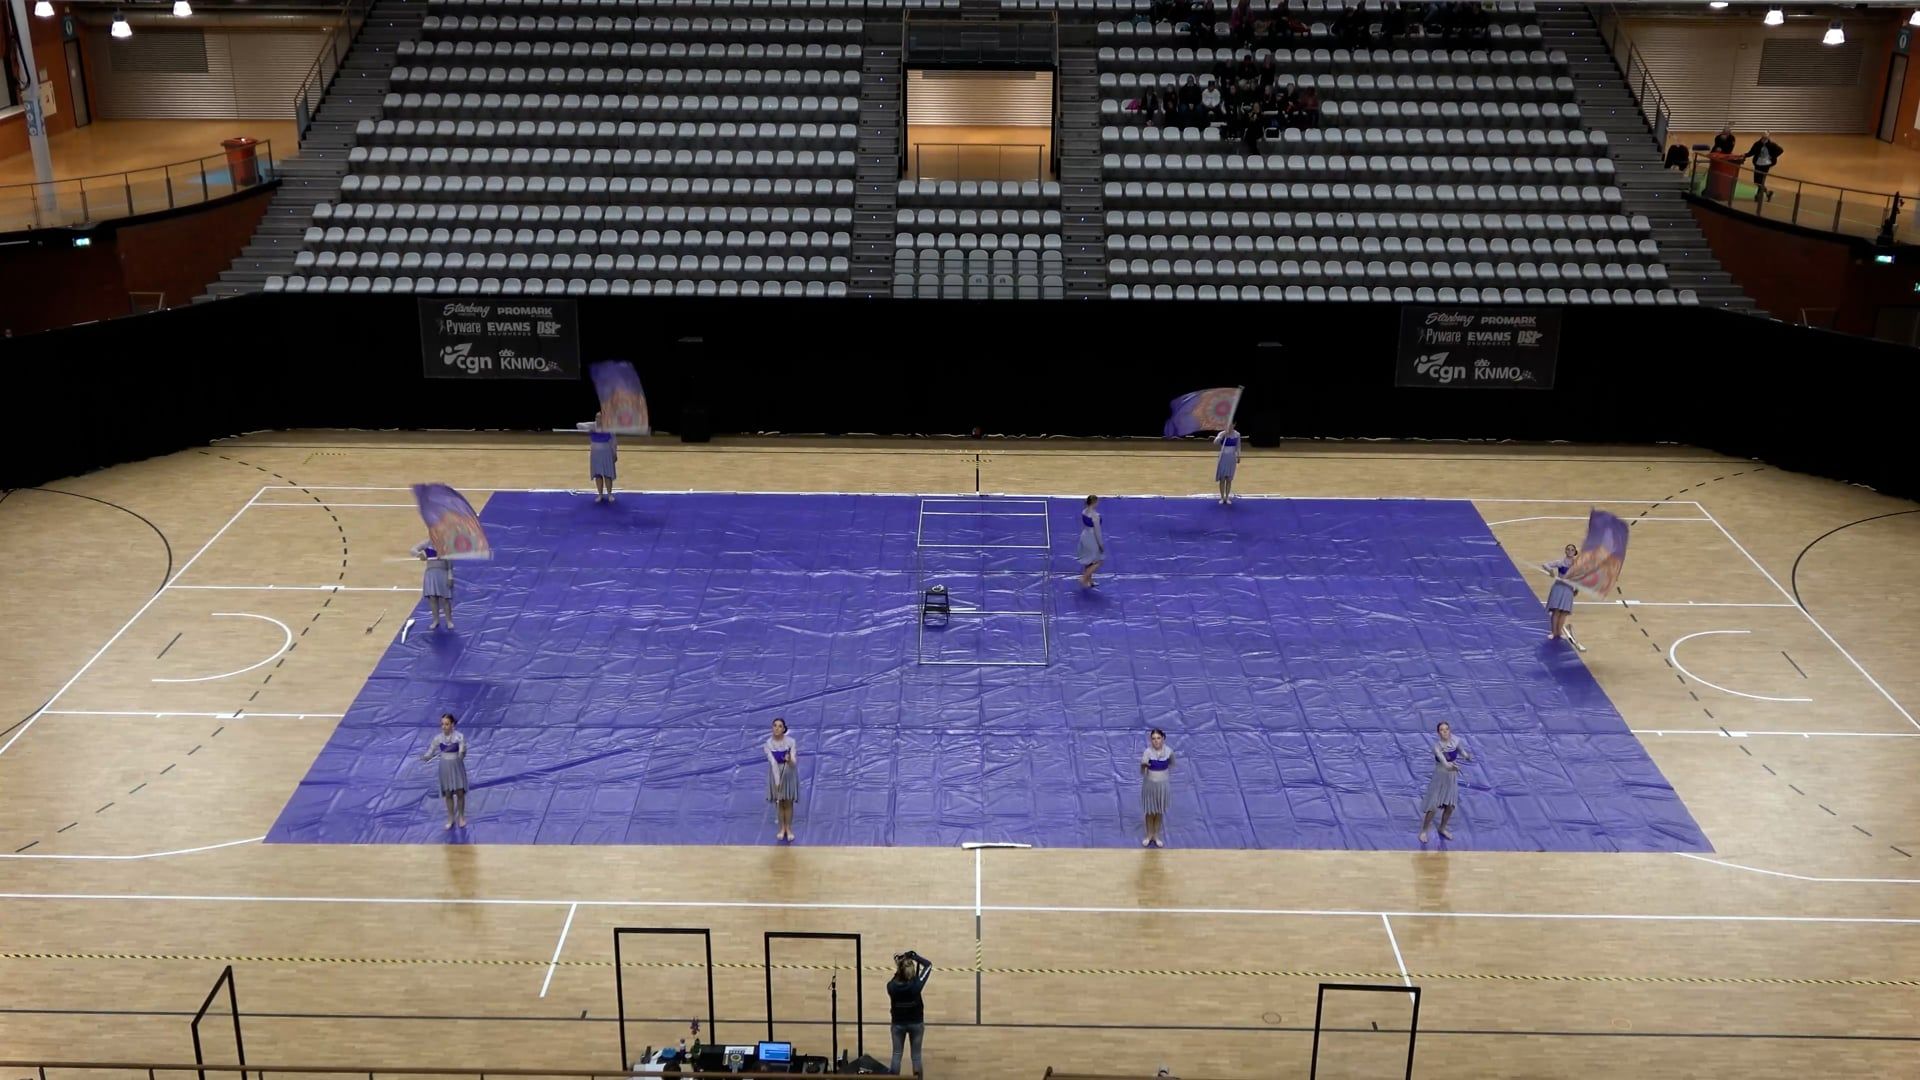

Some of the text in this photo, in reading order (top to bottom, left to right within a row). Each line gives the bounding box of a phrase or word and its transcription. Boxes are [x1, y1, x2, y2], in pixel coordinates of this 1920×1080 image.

[497, 307, 553, 316] PROMARK
[446, 319, 482, 335] Pyware
[487, 322, 531, 332] EVANS
[1481, 316, 1537, 325] PROMARK
[1426, 328, 1462, 344] Pyware
[1467, 331, 1512, 341] EVANS
[456, 355, 547, 374] cgn KNMO
[1429, 365, 1521, 384] cgn KNMO
